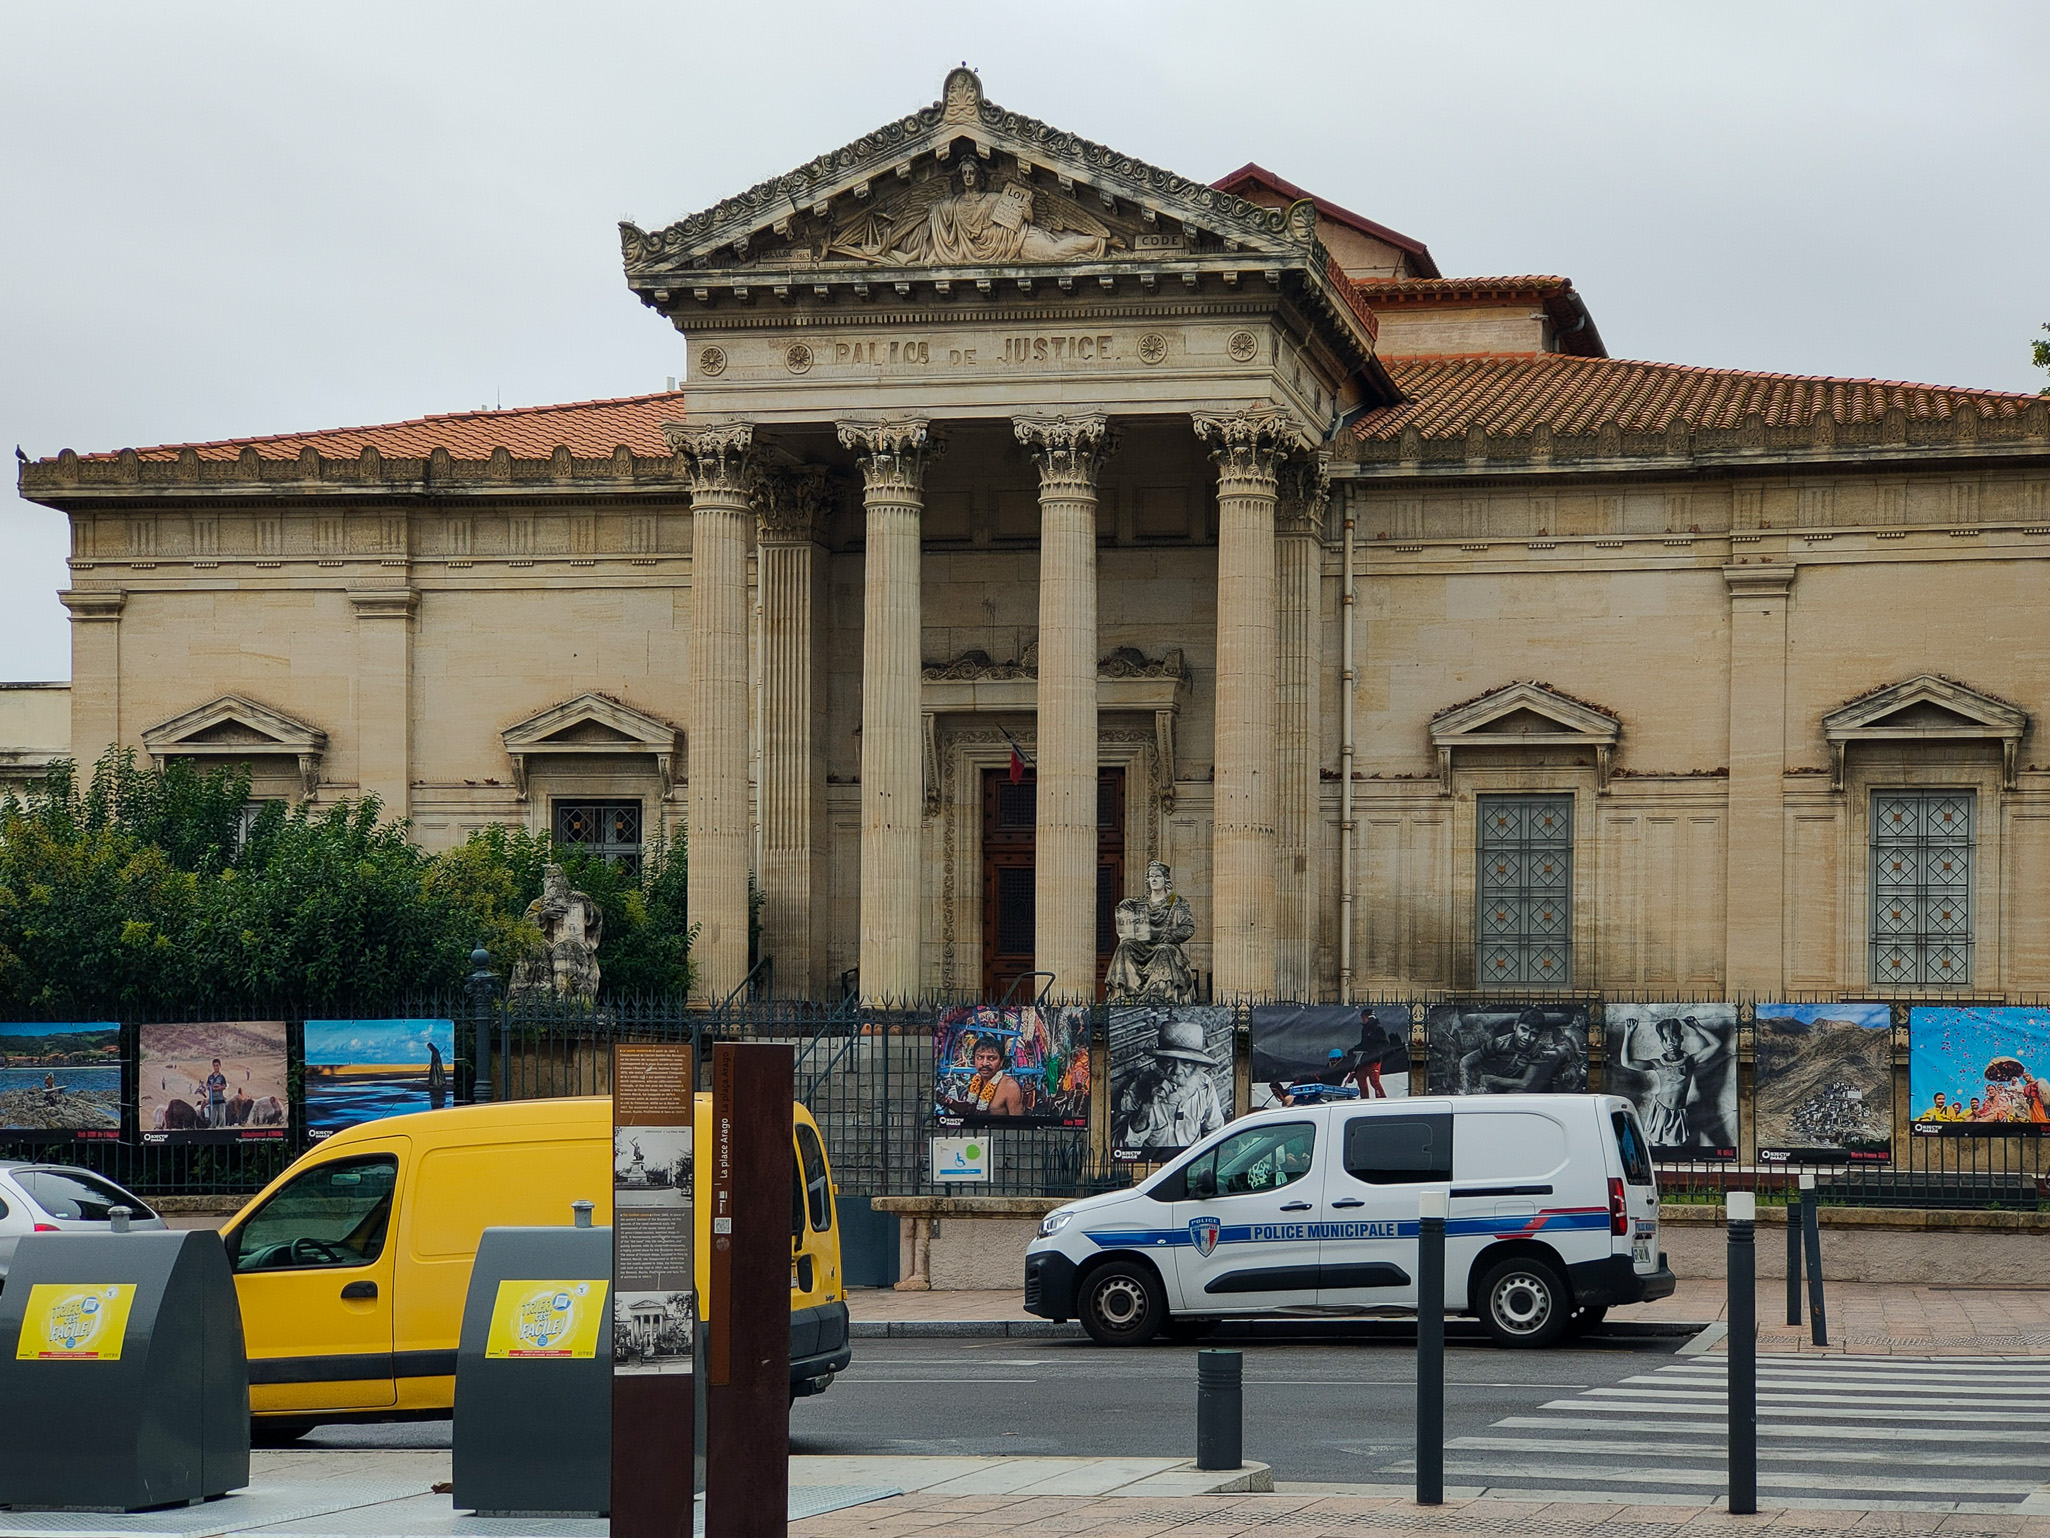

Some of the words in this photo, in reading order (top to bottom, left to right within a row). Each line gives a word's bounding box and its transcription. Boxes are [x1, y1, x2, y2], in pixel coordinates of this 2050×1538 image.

[1008, 187, 1025, 202] LOI
[1142, 236, 1179, 246] CODE
[949, 349, 977, 366] DE
[720, 1117, 731, 1144] Arago
[719, 1144, 730, 1167] place
[719, 1169, 728, 1179] La
[1254, 1225, 1304, 1240] POLICE
[1308, 1223, 1395, 1238] MUNICIPALE
